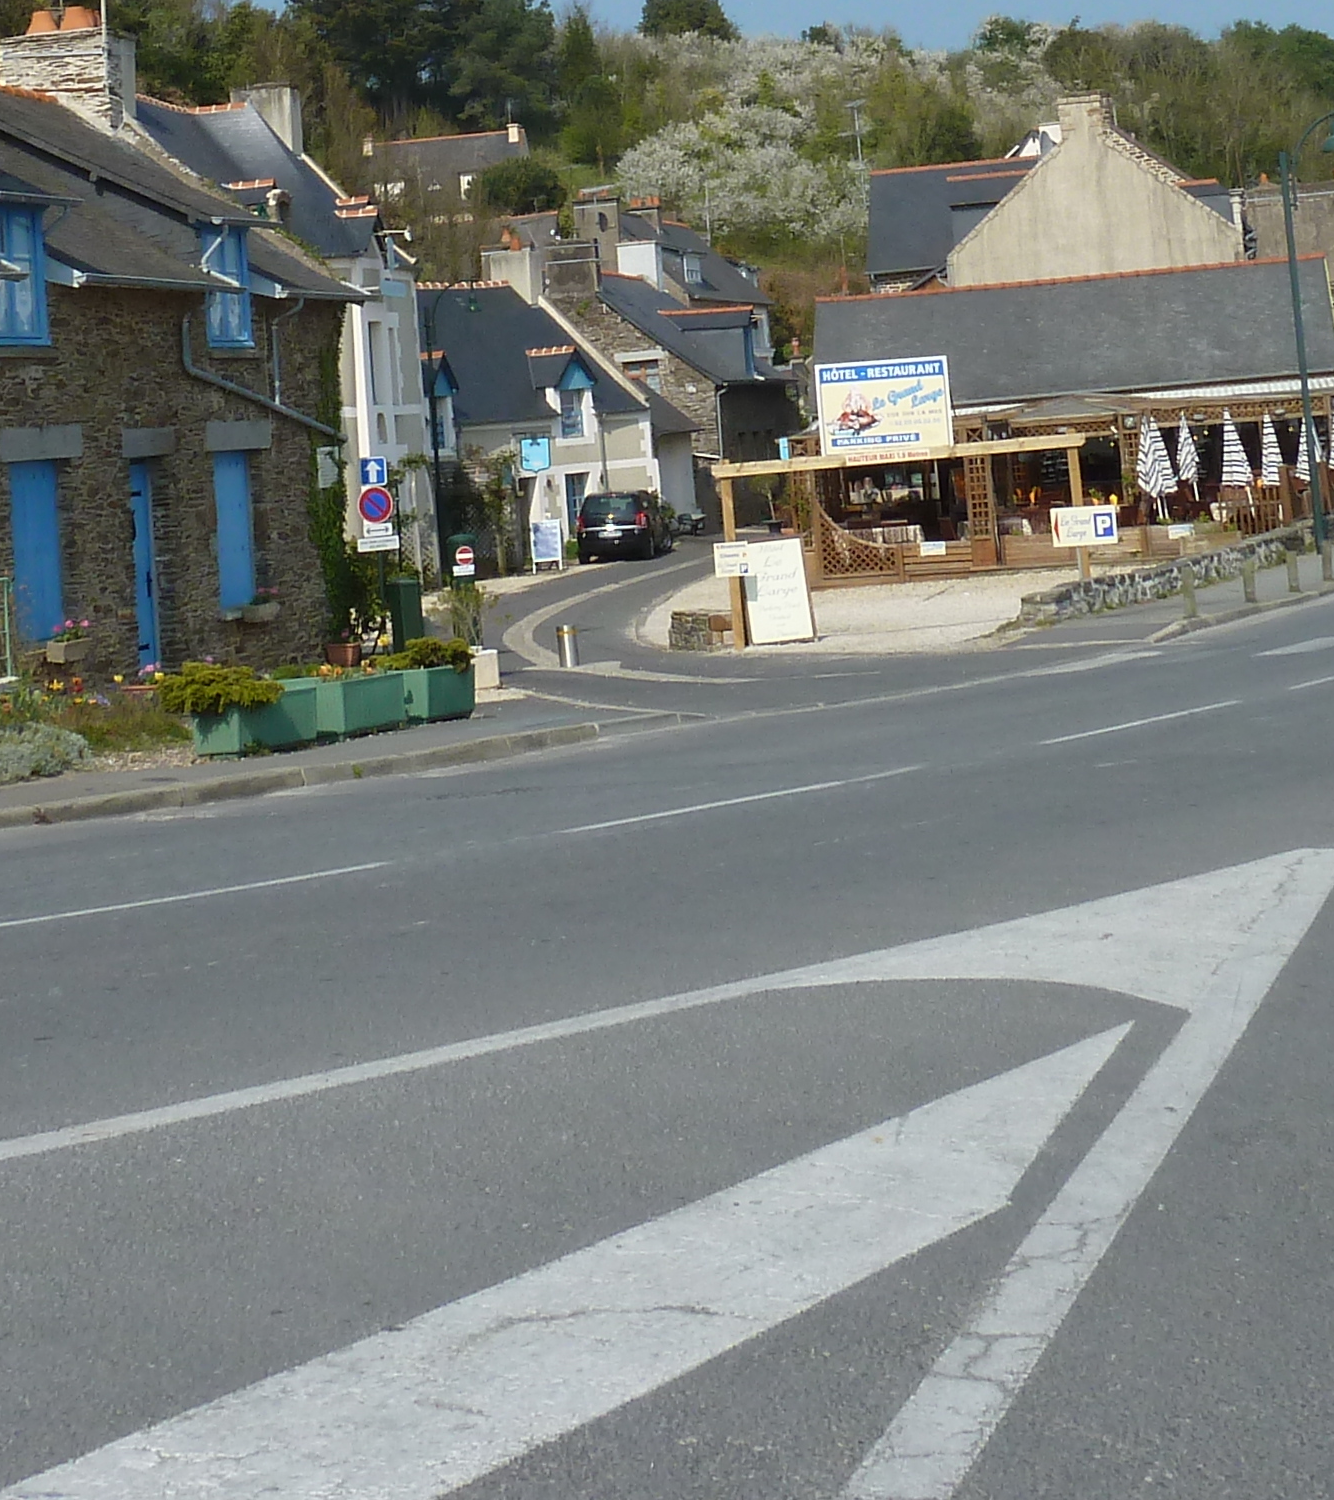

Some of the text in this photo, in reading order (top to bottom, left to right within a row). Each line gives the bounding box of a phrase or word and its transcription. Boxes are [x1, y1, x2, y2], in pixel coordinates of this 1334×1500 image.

[822, 367, 858, 381] HÔTEL
[867, 362, 941, 378] RESTAURANT
[887, 379, 923, 406] Grand
[911, 388, 944, 408] Large
[836, 436, 882, 446] PARKING
[848, 454, 878, 463] HAUTEUR
[1060, 514, 1092, 526] Le Grand
[1096, 516, 1111, 535] P
[1066, 527, 1087, 541] Large
[757, 567, 798, 582] Grand
[758, 583, 798, 599] Large
